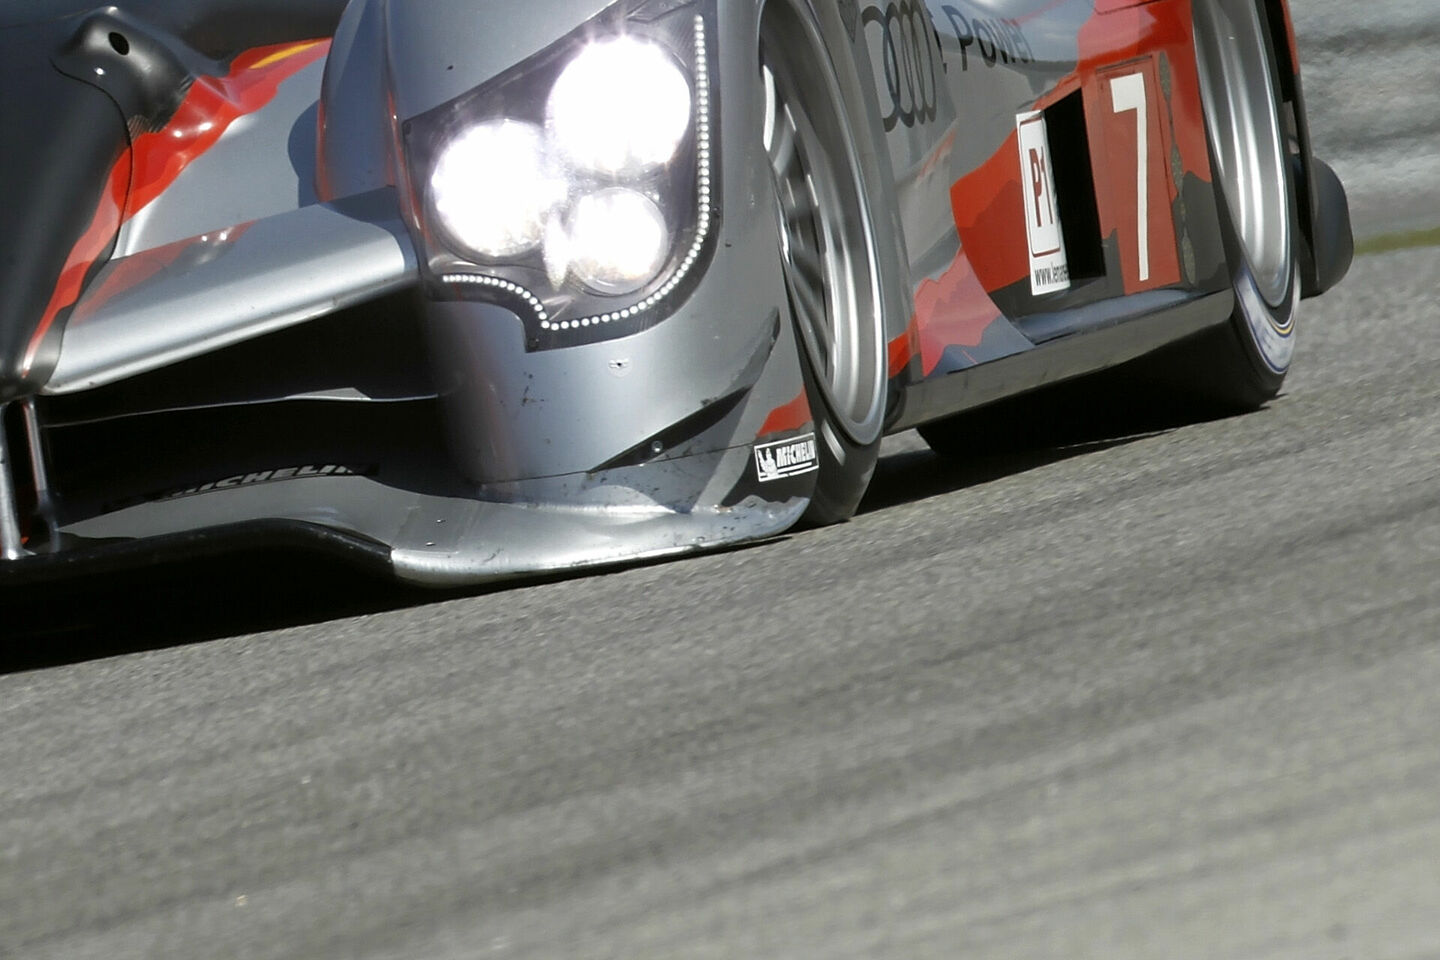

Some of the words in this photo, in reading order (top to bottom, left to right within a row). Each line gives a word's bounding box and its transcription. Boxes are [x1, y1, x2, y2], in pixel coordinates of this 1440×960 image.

[1028, 146, 1054, 228] P1
[1109, 71, 1149, 281] 7
[775, 440, 816, 468] MICHELIN
